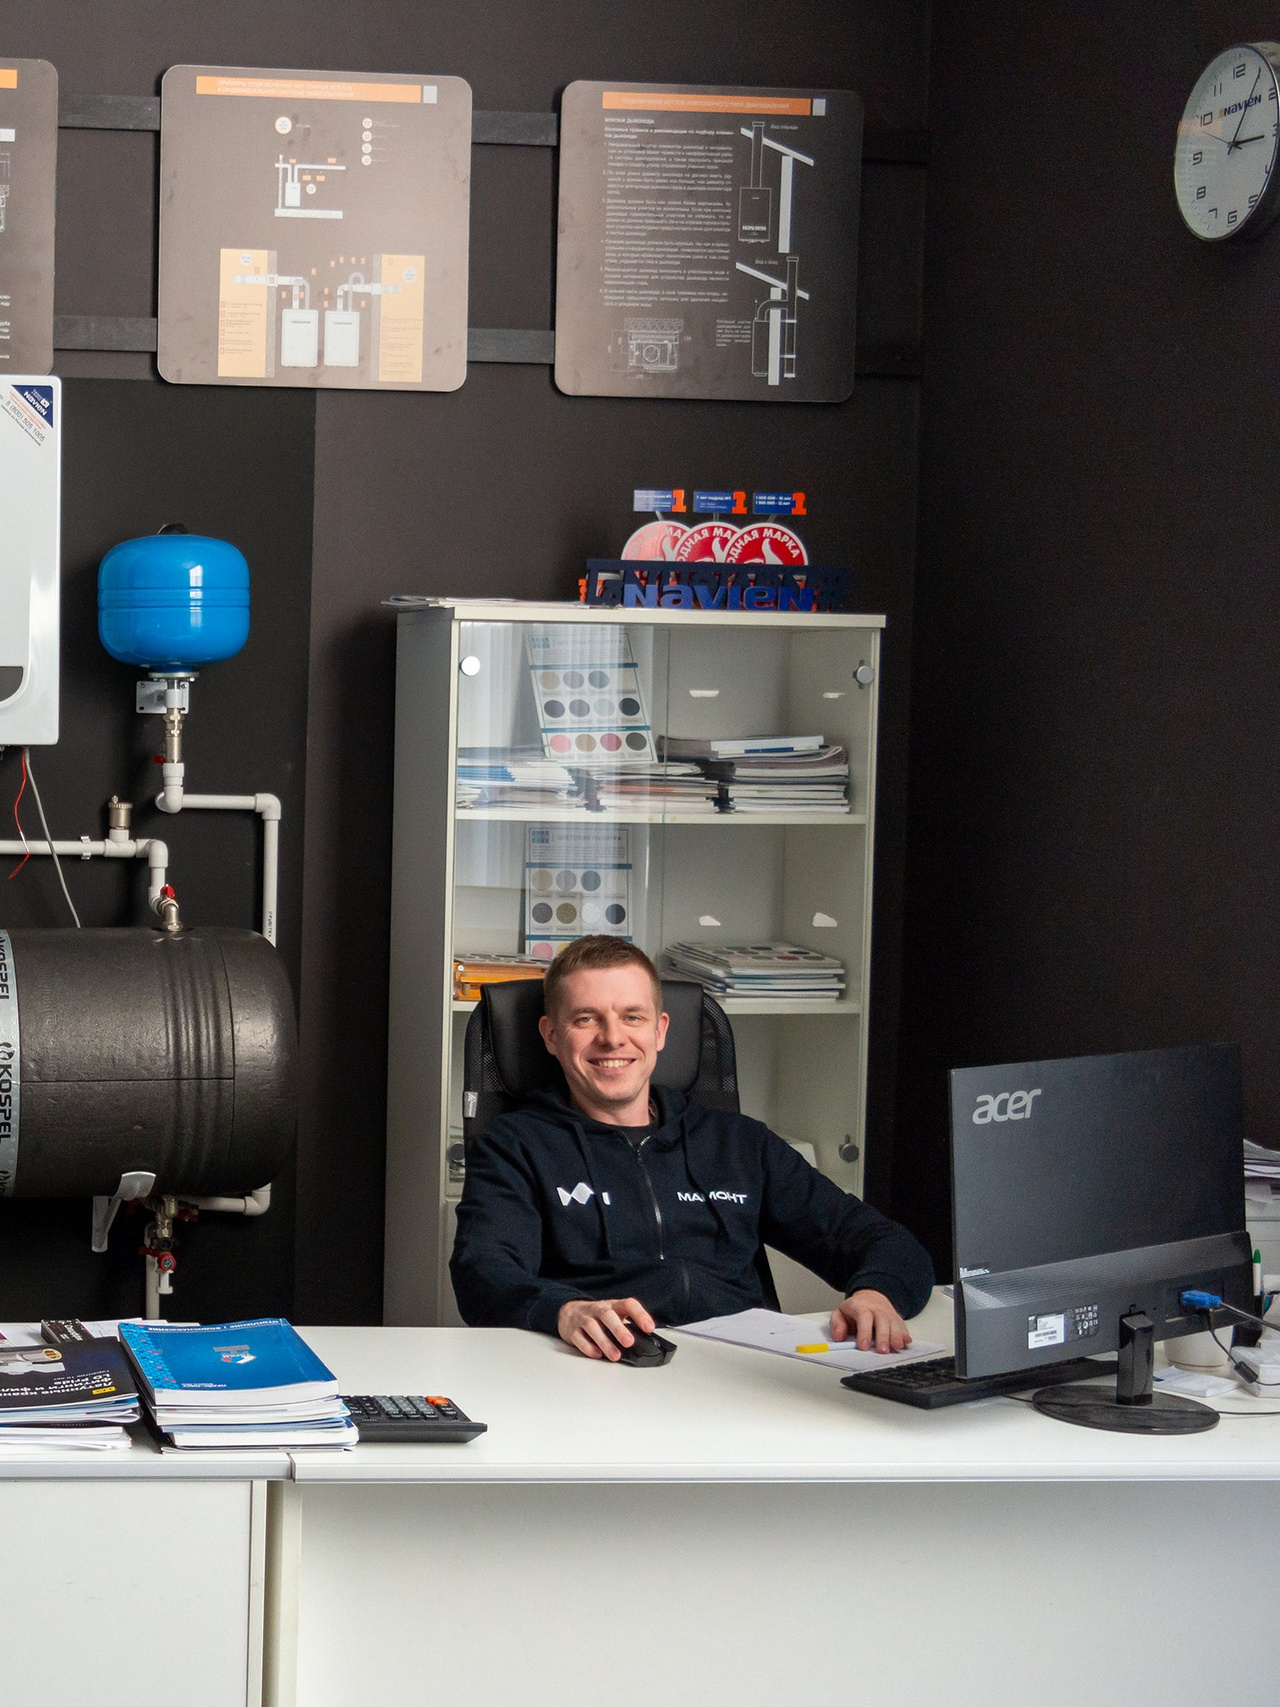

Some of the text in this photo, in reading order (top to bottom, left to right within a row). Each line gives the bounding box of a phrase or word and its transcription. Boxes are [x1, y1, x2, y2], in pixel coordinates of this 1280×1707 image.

[1232, 63, 1245, 79] 12
[1213, 82, 1222, 97] 11
[1200, 112, 1212, 127] 10
[1193, 151, 1202, 165] 9
[1197, 186, 1206, 200] 8
[1227, 210, 1237, 224] 6
[10, 405, 24, 420] (800)
[22, 418, 33, 429] 505
[33, 428, 45, 442] 1005
[763, 528, 800, 558] МАРКА
[972, 1088, 1042, 1125] acer
[48, 1377, 112, 1390] фитинги
[54, 1376, 90, 1386] Pride
[41, 1382, 113, 1396] Латунные
